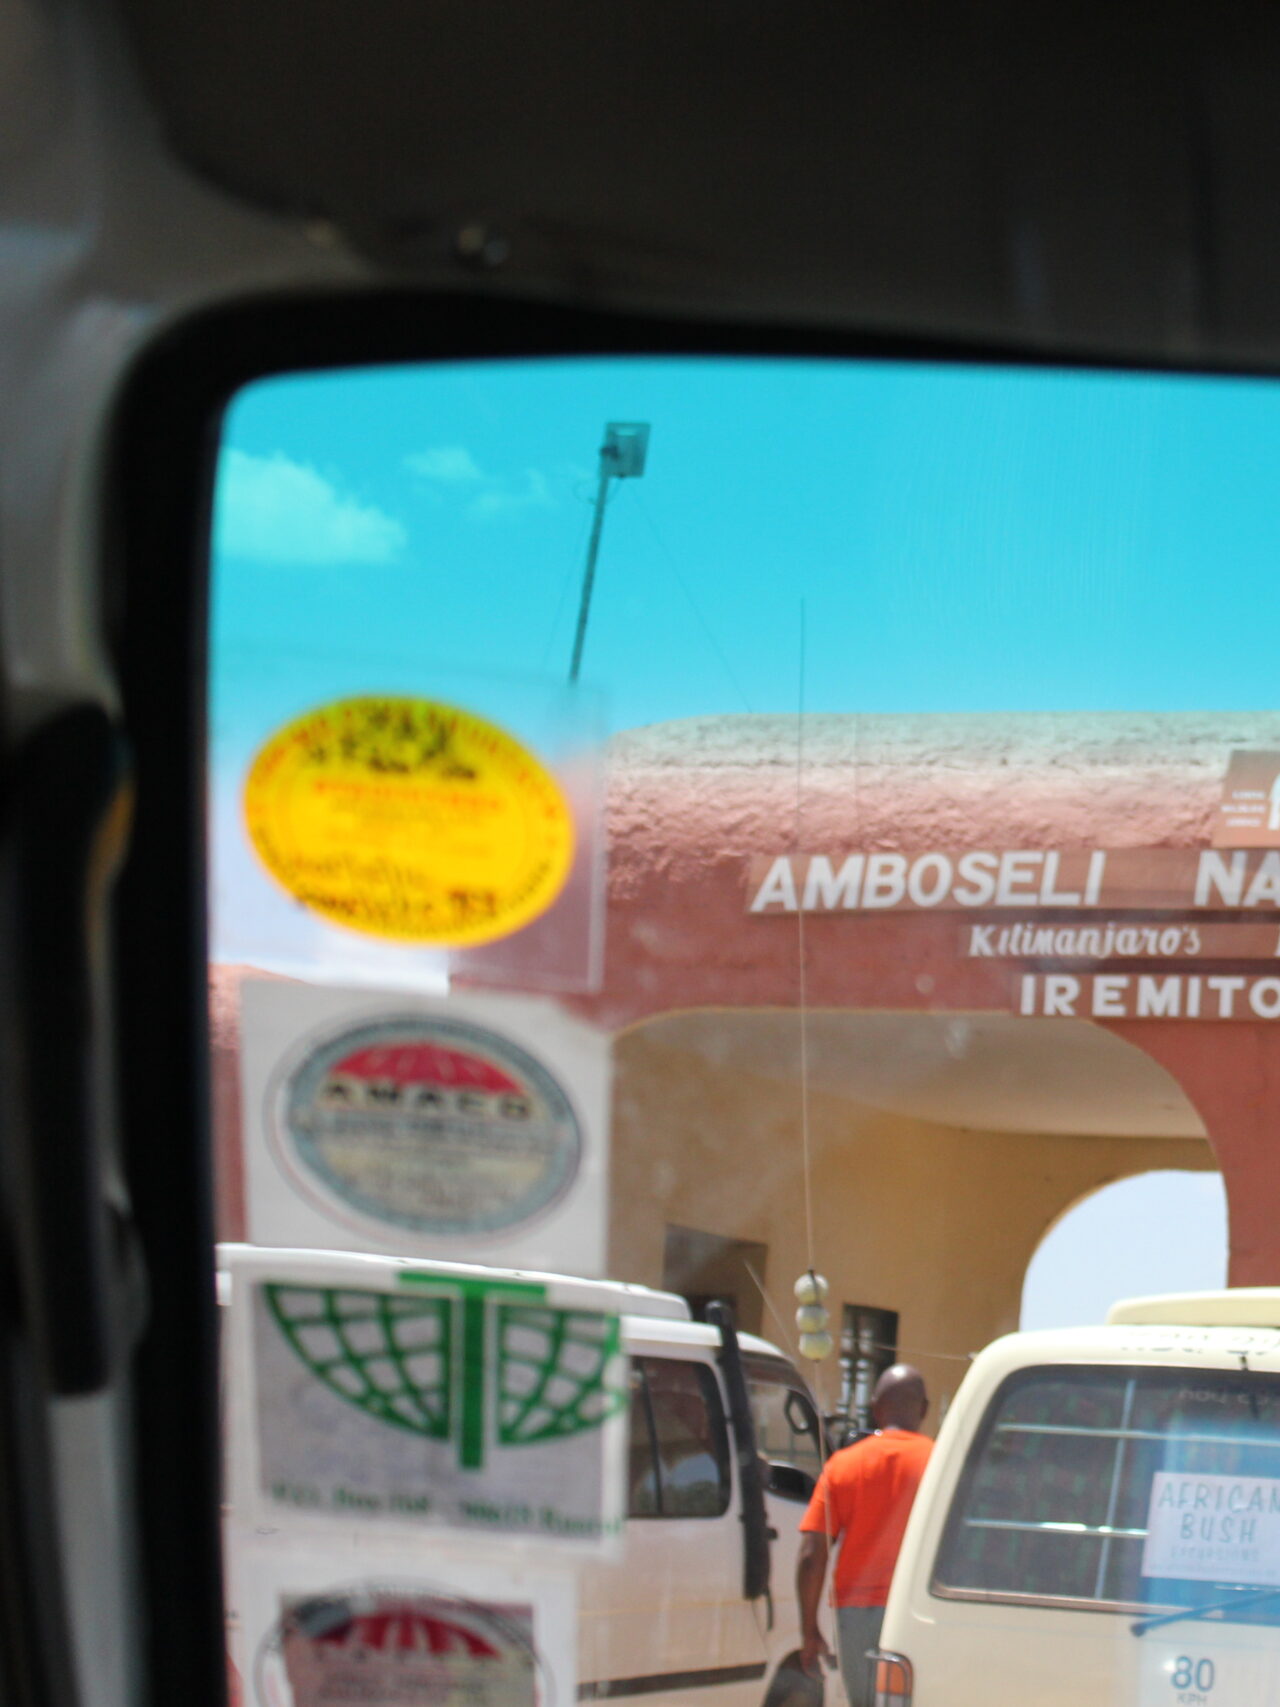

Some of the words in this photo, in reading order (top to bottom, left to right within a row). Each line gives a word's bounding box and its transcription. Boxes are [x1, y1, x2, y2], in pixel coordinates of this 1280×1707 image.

[748, 850, 1106, 912] AMBOSELI
[968, 922, 1201, 960] Kilimanjaro's
[1178, 1512, 1257, 1542] BUSH
[1170, 1655, 1216, 1693] 80
